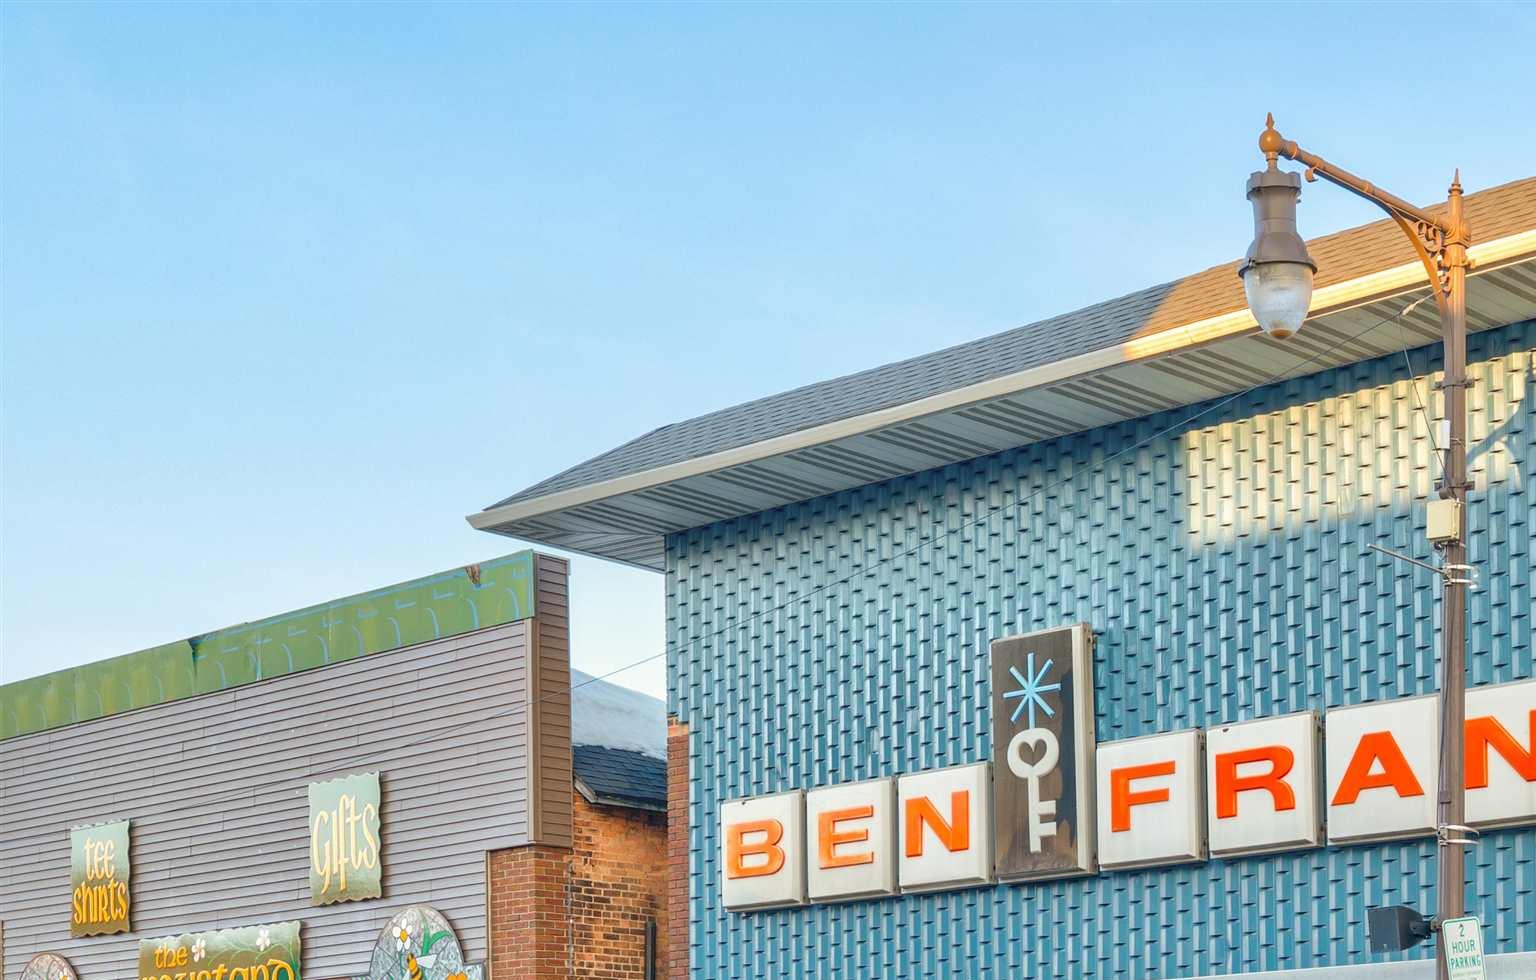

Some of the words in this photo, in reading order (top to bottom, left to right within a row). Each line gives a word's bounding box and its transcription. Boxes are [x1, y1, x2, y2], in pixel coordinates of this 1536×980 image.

[726, 789, 970, 880] BEN
[1458, 923, 1465, 937] 2
[1452, 939, 1476, 954] HOUR
[154, 944, 188, 969] the
[1450, 955, 1481, 970] PARKING
